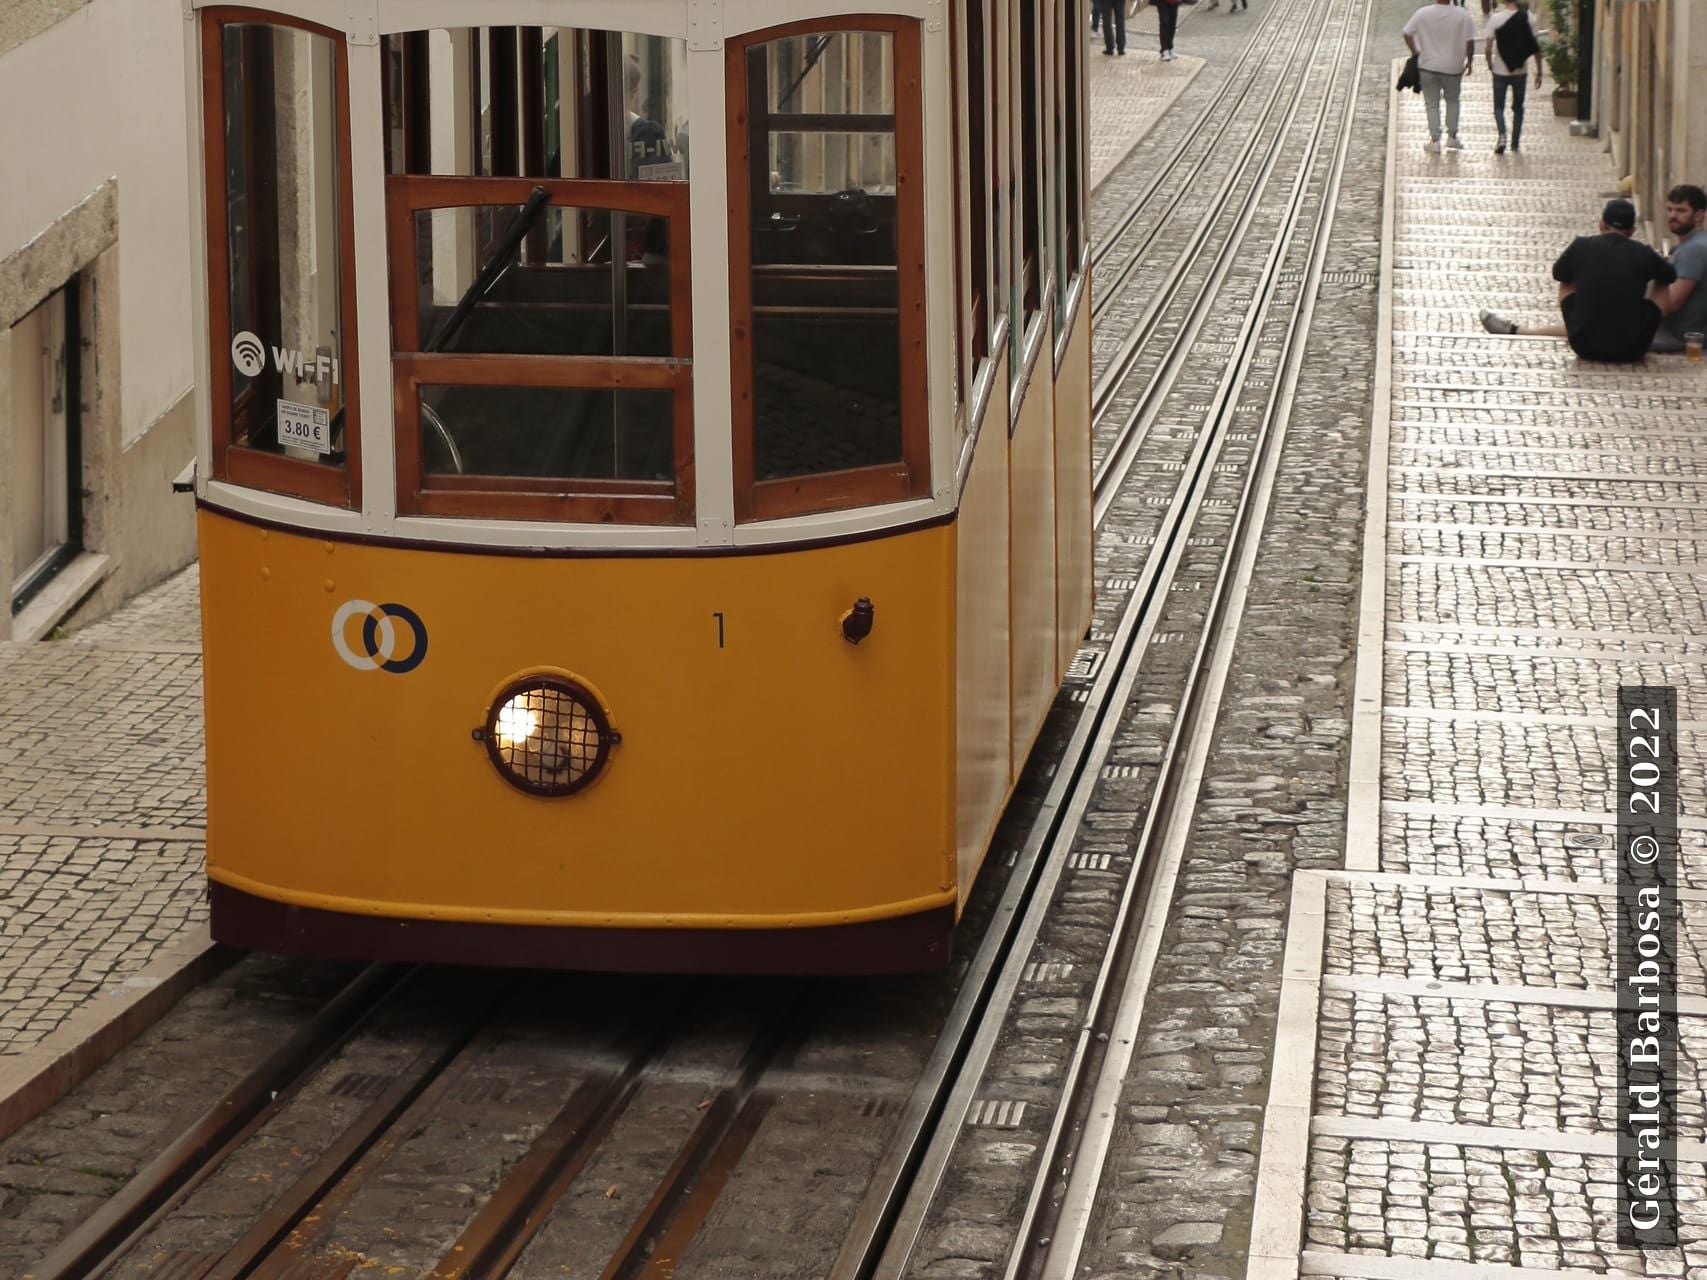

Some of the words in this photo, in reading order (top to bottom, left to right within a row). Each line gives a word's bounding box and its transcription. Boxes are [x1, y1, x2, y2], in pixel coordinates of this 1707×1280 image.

[271, 346, 339, 385] WI-FI
[284, 420, 310, 438] 3.80
[313, 426, 321, 440] €
[712, 612, 724, 649] 1
